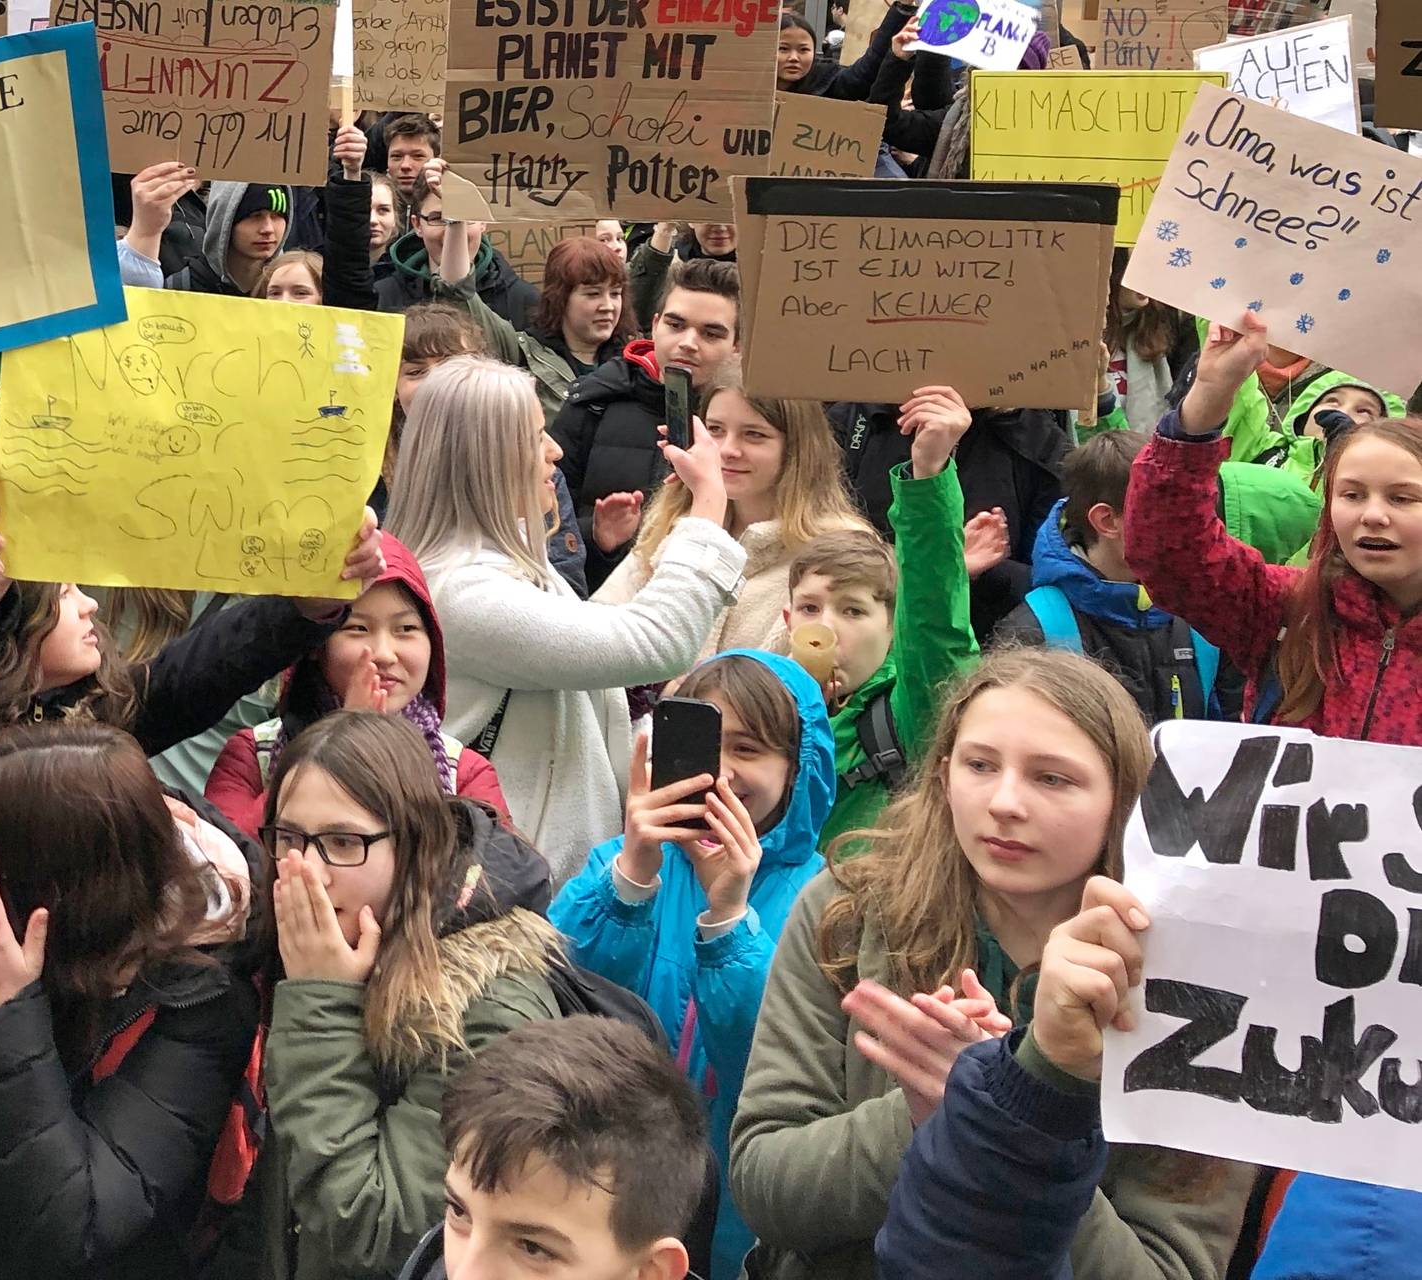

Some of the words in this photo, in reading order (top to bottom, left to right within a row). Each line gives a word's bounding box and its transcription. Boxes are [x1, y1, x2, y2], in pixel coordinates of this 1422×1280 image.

[475, 0, 522, 27] ES
[526, 0, 575, 27] IST
[587, 0, 648, 28] DER
[657, 0, 780, 38] EINZIGE
[1104, 7, 1147, 37] NO
[496, 31, 627, 82] PLANET
[641, 33, 718, 80] MIT
[458, 86, 555, 145] BIER,
[561, 81, 710, 146] Schoki
[723, 128, 771, 156] UND
[974, 88, 1200, 133] KLIMASCHUT
[484, 151, 591, 208] Harry
[606, 144, 720, 213] Potter
[1290, 153, 1362, 197] was
[1370, 169, 1422, 221] ist
[778, 220, 841, 253] DIE
[859, 223, 1066, 253] KLIMAPOLITIK
[793, 258, 840, 284] IST
[859, 258, 921, 280] EIN
[935, 259, 1016, 288] WITZ!
[781, 295, 851, 318] Aber
[871, 290, 993, 319] KEINER
[827, 343, 936, 373] LACHT
[988, 385, 1005, 398] HA
[1008, 371, 1024, 383] HA
[1050, 348, 1068, 361] HA
[1072, 339, 1090, 351] HA
[477, 723, 498, 753] VANS
[1140, 726, 1370, 882] Wir
